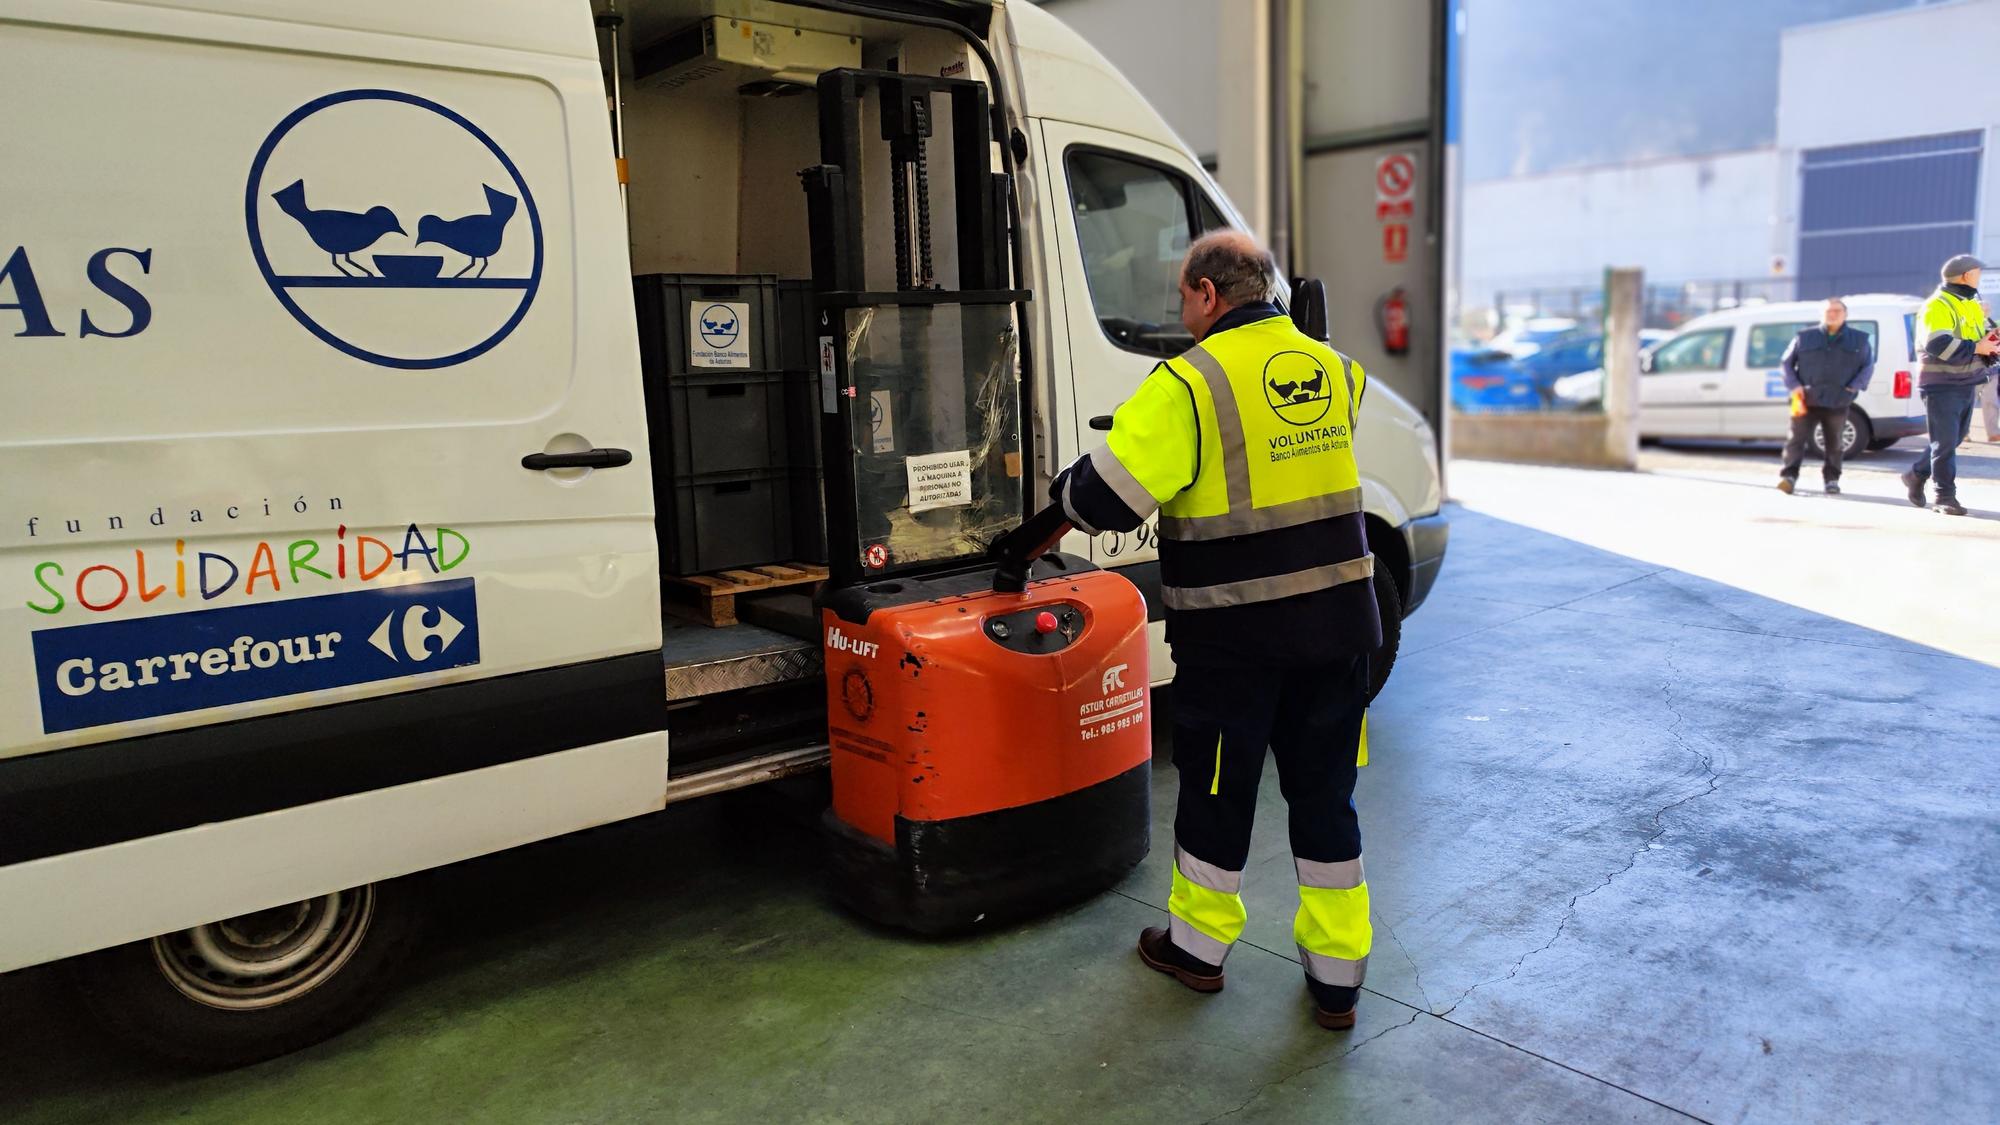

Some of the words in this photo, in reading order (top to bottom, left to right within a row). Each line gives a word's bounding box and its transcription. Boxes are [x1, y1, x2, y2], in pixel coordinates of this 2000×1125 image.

[1268, 425, 1347, 449] VOLUNTARIO
[1270, 451, 1290, 462] Banco
[1291, 444, 1321, 459] Alimentos
[1322, 441, 1330, 452] de
[1330, 439, 1349, 450] Asturias
[912, 462, 948, 472] PROHIBIDO
[949, 460, 965, 468] USAR
[919, 482, 950, 491] PERSONAS
[951, 480, 962, 488] NO
[919, 490, 962, 502] AUTORIZADAS
[26, 495, 344, 537] fundación
[56, 631, 342, 696] Carrefour
[1080, 700, 1104, 716] ASTUR
[1105, 687, 1144, 708] CARRETILLAS
[1081, 727, 1099, 741] Tel.:
[1100, 722, 1116, 736] 985
[1117, 716, 1131, 730] 985
